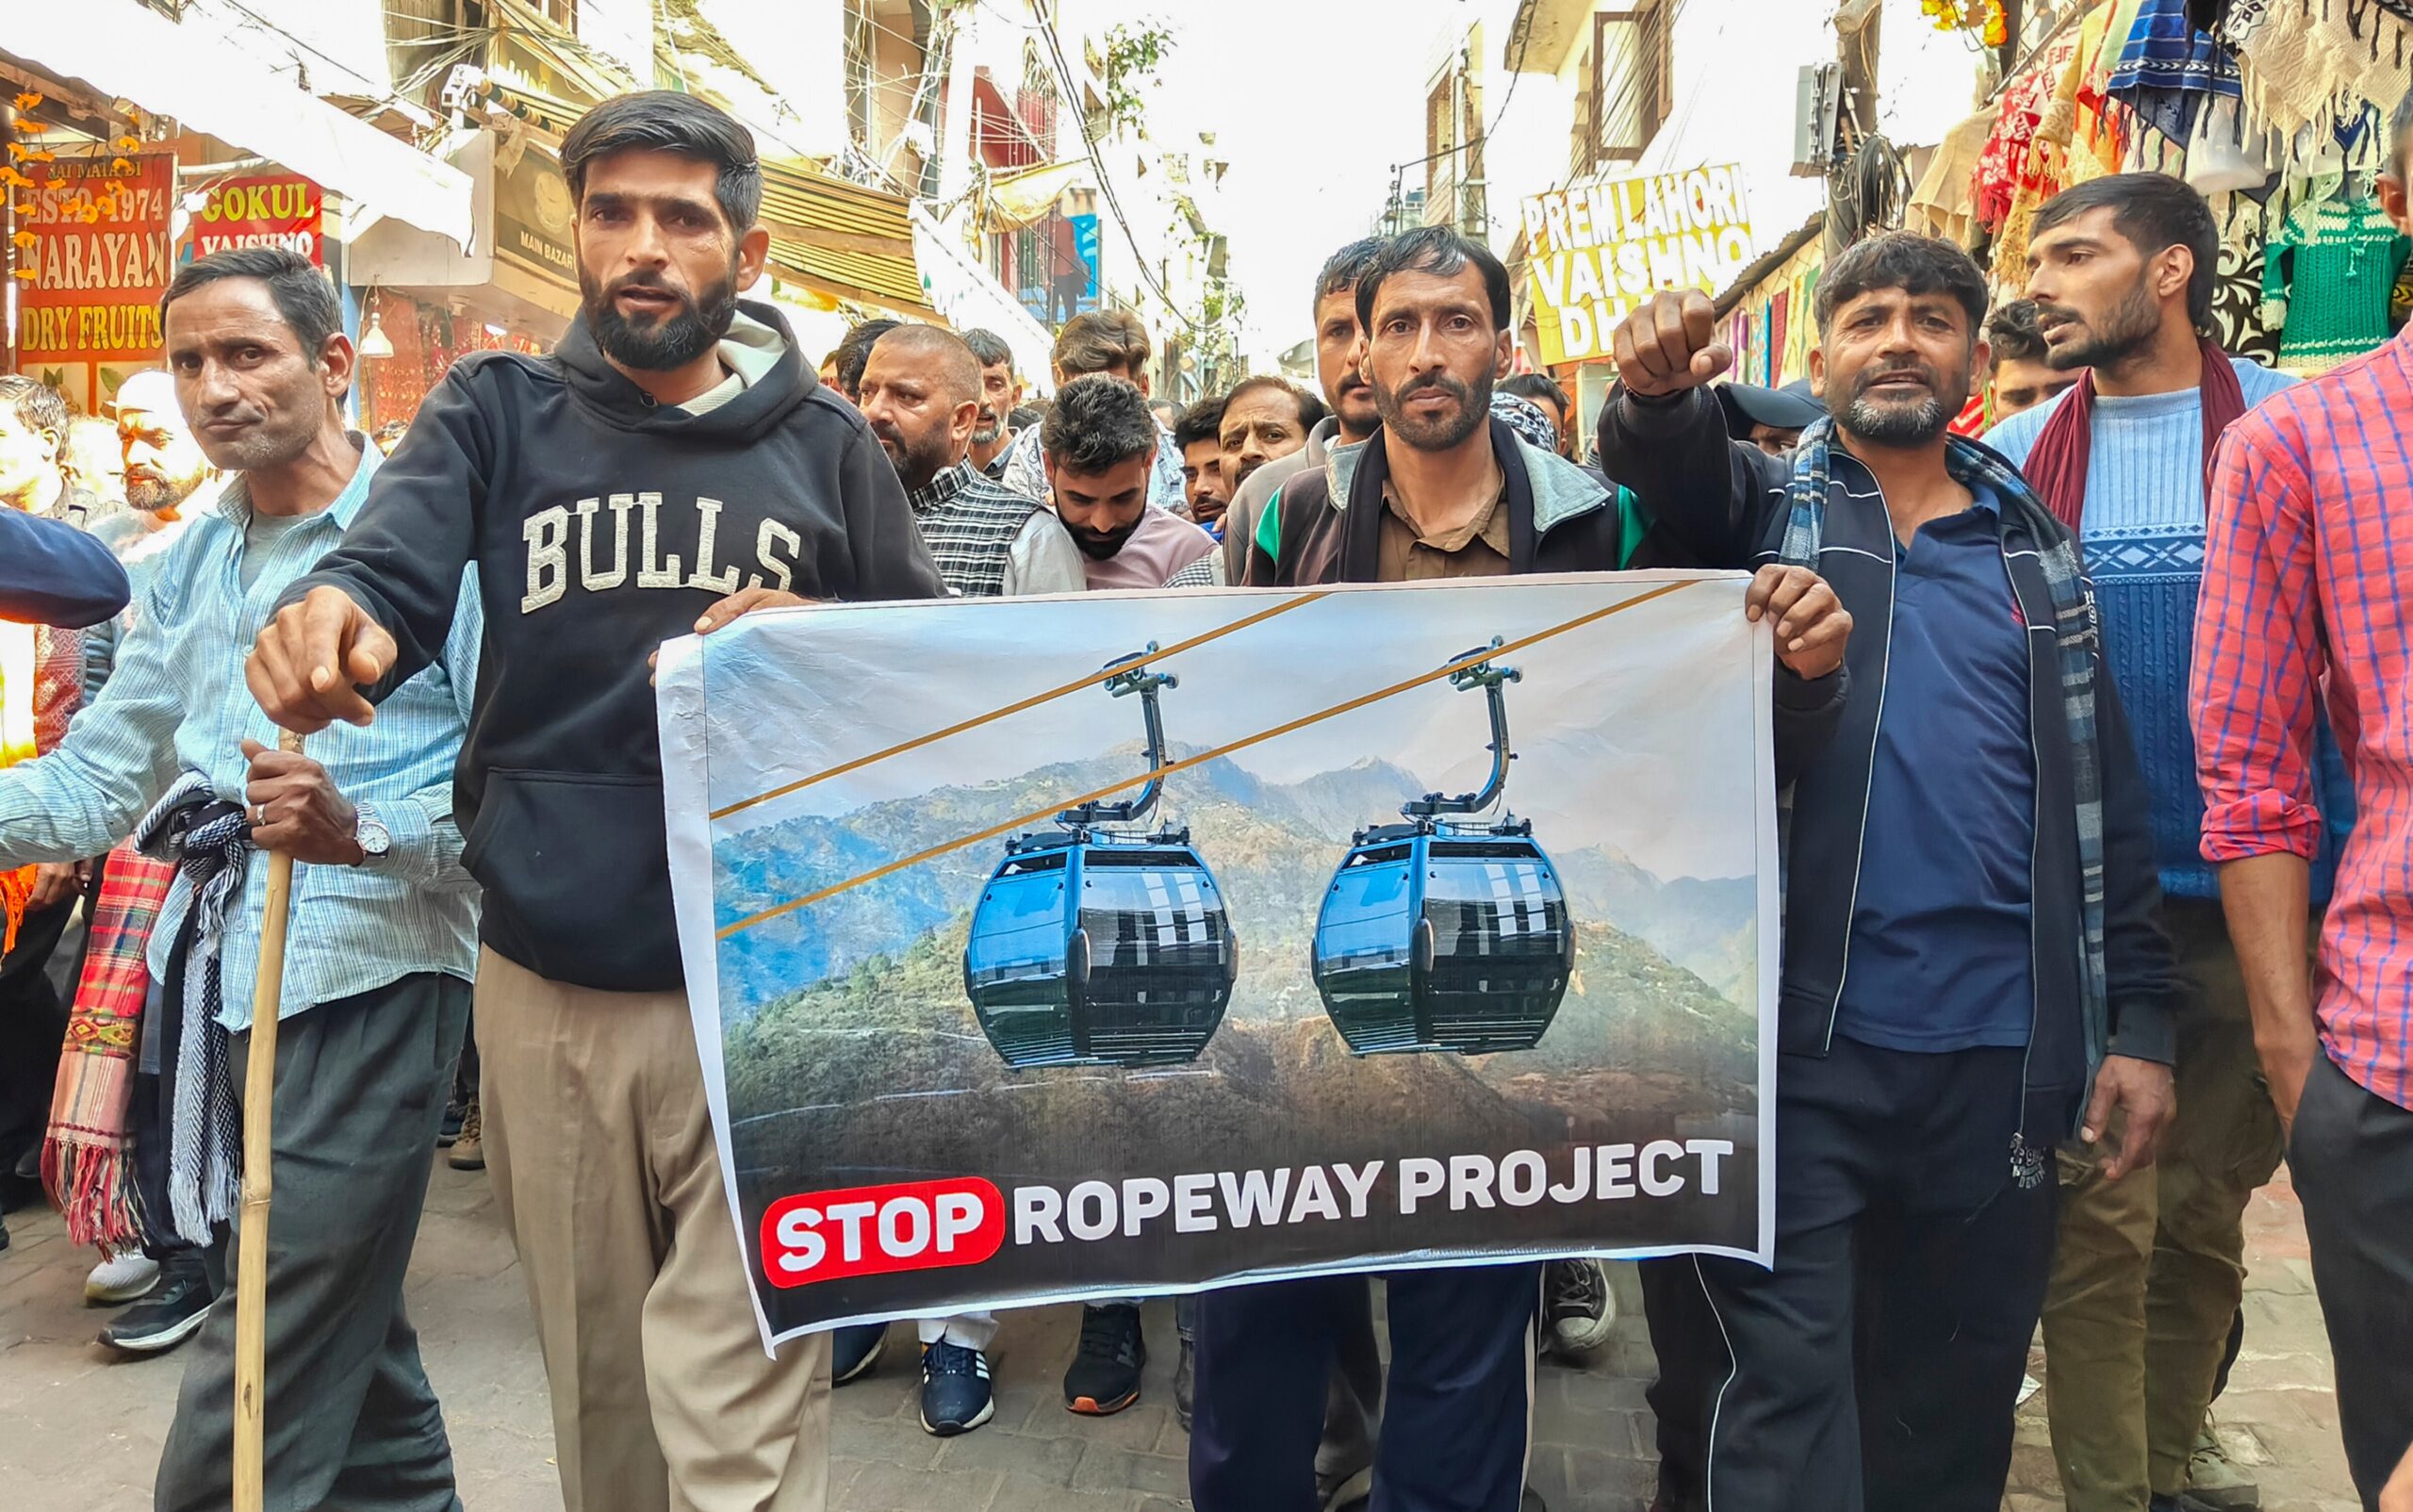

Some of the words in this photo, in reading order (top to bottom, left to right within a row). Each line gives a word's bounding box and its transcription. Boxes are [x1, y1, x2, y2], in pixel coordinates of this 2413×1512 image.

[202, 183, 315, 222] GOKUL
[1521, 182, 1618, 255] PREM
[1617, 164, 1748, 241] LAHORI
[21, 231, 168, 290] NARAYAN
[520, 230, 544, 255] MAIN
[544, 243, 573, 270] BAZAR
[1531, 225, 1755, 308] VAISHNO
[22, 306, 73, 351] DRY
[77, 304, 164, 350] FRUITS
[520, 491, 802, 615] BULLS
[776, 1192, 984, 1272] STOP
[1013, 1159, 1385, 1245] ROPEWAY
[1399, 1139, 1733, 1215] PROJECT
